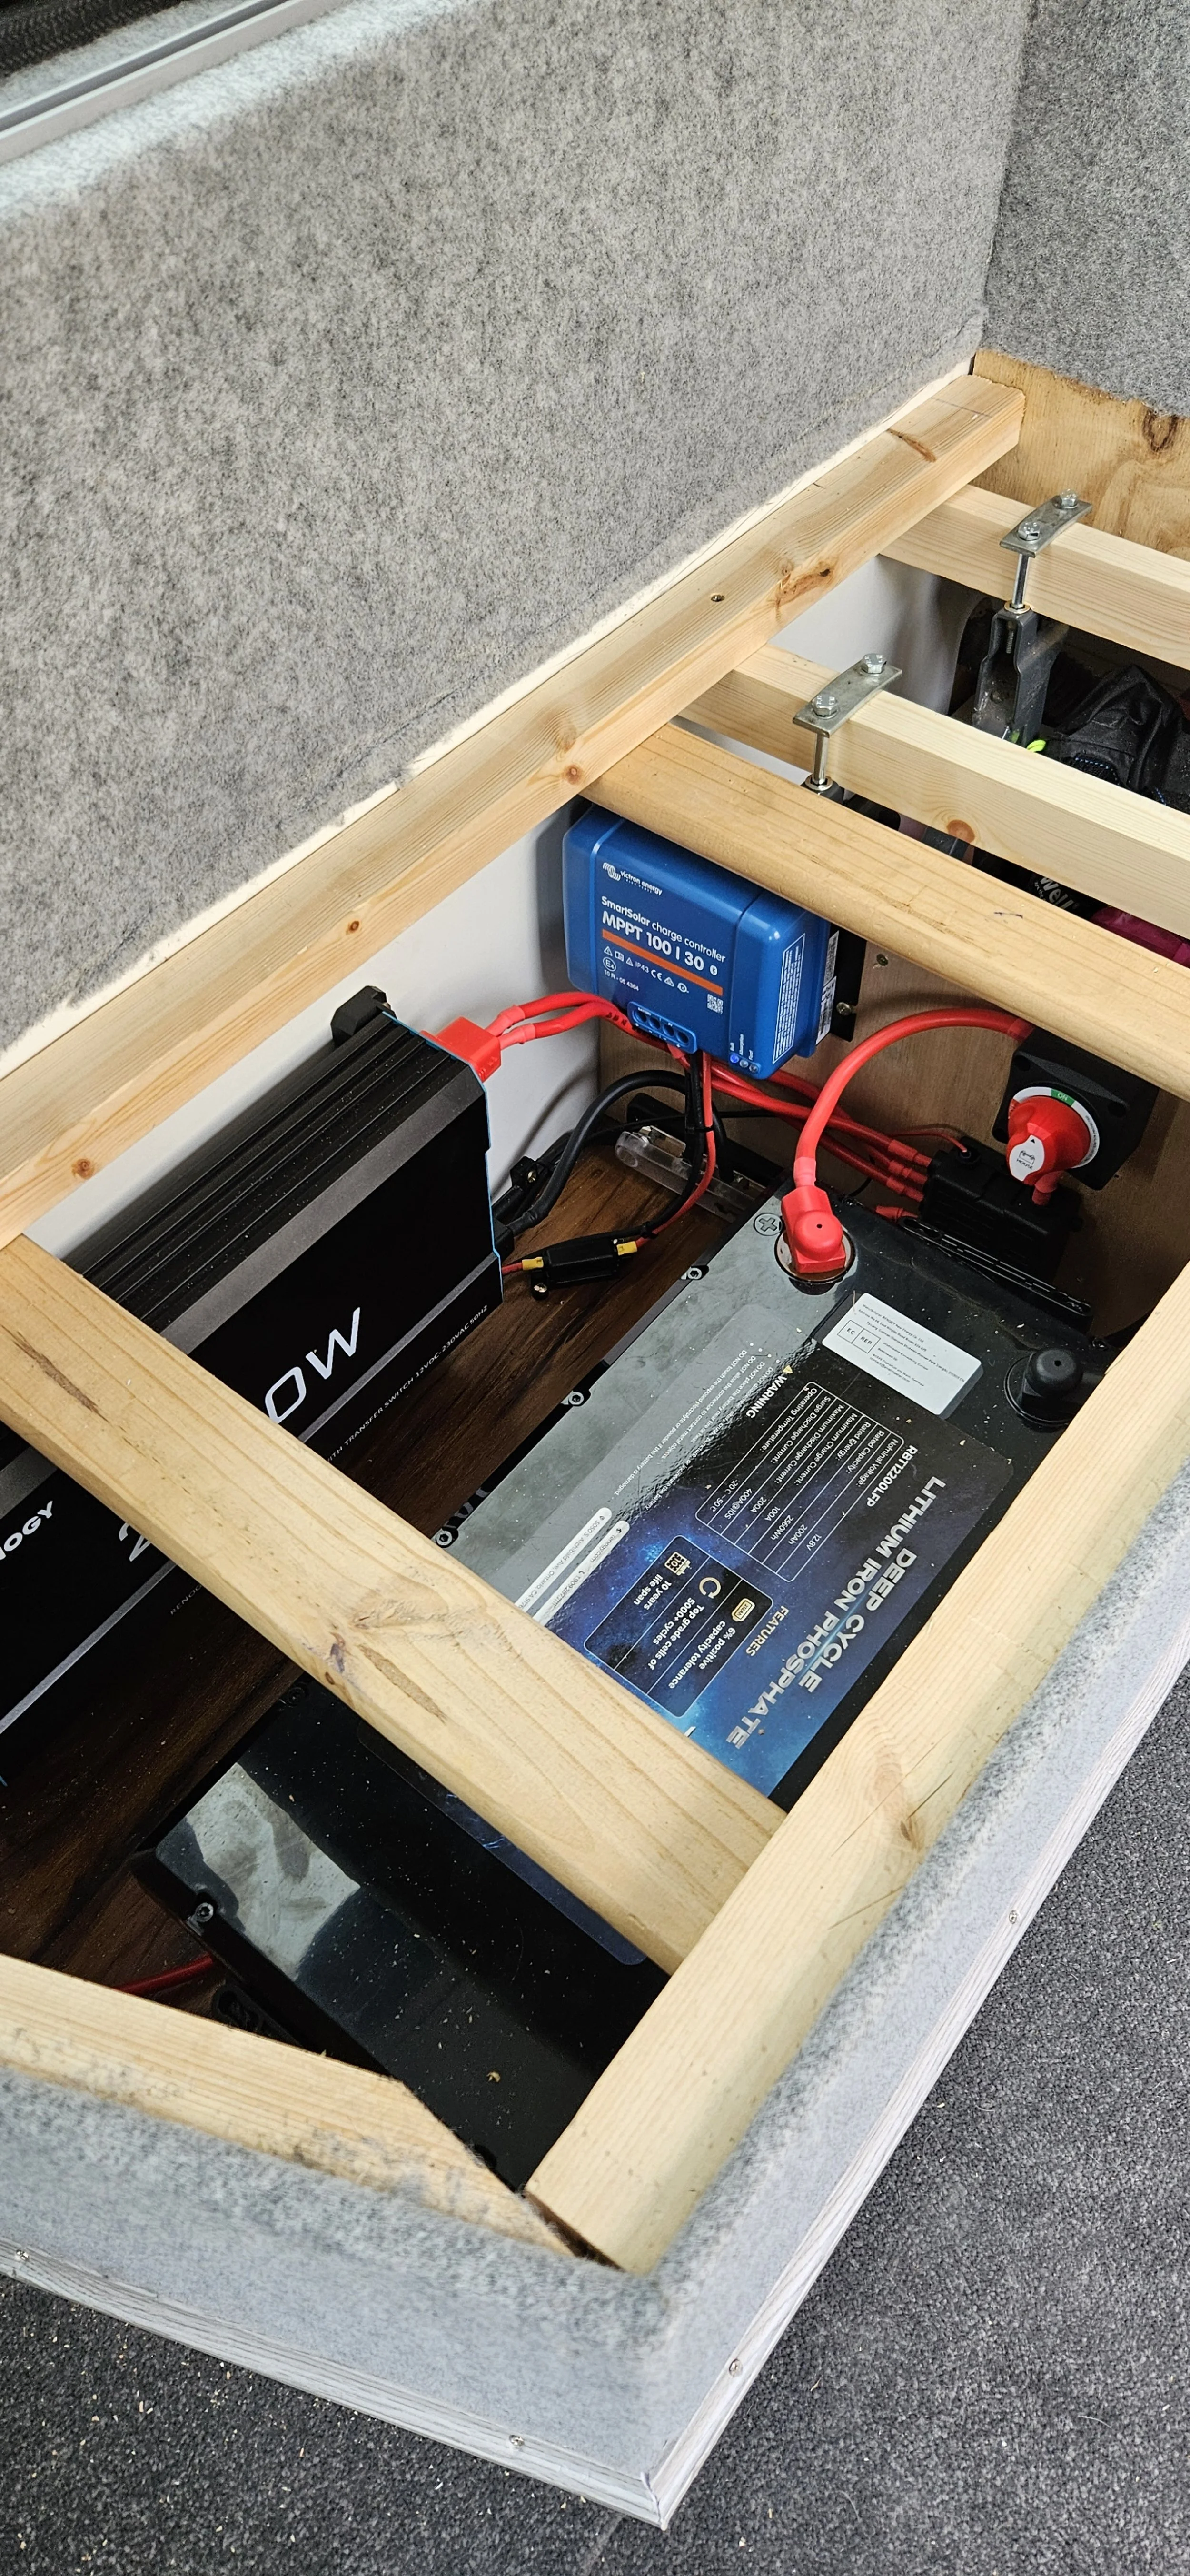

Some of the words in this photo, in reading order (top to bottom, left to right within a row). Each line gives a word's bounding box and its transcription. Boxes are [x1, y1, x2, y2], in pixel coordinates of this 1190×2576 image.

[620, 871, 640, 884] victron
[641, 881, 662, 895] energy
[601, 896, 651, 926] SmartSolar
[652, 922, 682, 942] charge
[684, 938, 726, 963] controller
[602, 911, 643, 941] MPPT
[646, 932, 672, 955] 100
[684, 951, 704, 971] 30
[635, 961, 649, 973] IP43
[1057, 1093, 1068, 1101] ON
[1016, 1158, 1034, 1170] HOUSE
[845, 1327, 856, 1335] EC
[859, 1336, 873, 1345] REP
[729, 1356, 741, 1367] NOT
[737, 1349, 747, 1359] DO
[746, 1355, 756, 1364] DO
[719, 1365, 733, 1379] touch
[739, 1362, 750, 1373] NOT
[747, 1368, 759, 1380] NOT
[755, 1361, 765, 1370] DO
[764, 1366, 774, 1375] DO
[327, 1446, 343, 1462] ITH
[344, 1407, 383, 1445] TRANSFER
[384, 1377, 413, 1408] SWITCH
[470, 1304, 487, 1324] 50HZ
[712, 1377, 723, 1386] the
[723, 1382, 733, 1391] the
[729, 1371, 742, 1384] allow
[737, 1376, 751, 1391] place
[755, 1373, 767, 1385] NOT
[696, 1383, 716, 1403] exposed
[704, 1389, 726, 1412] connector
[717, 1394, 735, 1412] battery
[731, 1388, 742, 1398] the
[744, 1373, 787, 1420] WARNING
[789, 1386, 818, 1417] Operating
[678, 1400, 701, 1425] electrolyte
[812, 1394, 831, 1414] Surge
[686, 1414, 704, 1432] contact
[703, 1420, 714, 1430] fire
[710, 1410, 721, 1421] near
[817, 1403, 844, 1434] Maximum
[660, 1426, 677, 1445] powder
[675, 1430, 689, 1444] metal
[758, 1413, 795, 1454] Temperature:
[789, 1411, 817, 1442] Discharge
[830, 1412, 858, 1442] Maximum
[853, 1421, 871, 1440] Rated
[793, 1430, 821, 1462] Discharge
[833, 1436, 857, 1462] Energy:
[866, 1429, 885, 1449] Rated
[650, 1446, 660, 1456] the
[769, 1438, 794, 1465] Current:
[812, 1439, 835, 1463] Charge
[843, 1444, 872, 1475] Capacity:
[874, 1437, 899, 1465] Nominal
[635, 1453, 653, 1472] battery
[774, 1458, 798, 1485] Current:
[793, 1460, 817, 1487] Current:
[854, 1461, 879, 1488] Voltage:
[867, 1445, 918, 1506] RBT12200LFP
[658, 1485, 669, 1496] the
[644, 1492, 662, 1512] battery
[723, 1486, 753, 1520] 400A@10S
[749, 1496, 766, 1514] 200A
[764, 1504, 780, 1522] 100A
[875, 1476, 946, 1558] LITHIUM
[586, 1519, 600, 1534] 5050
[769, 1514, 793, 1542] 2560Wh
[787, 1523, 808, 1546] 200Ah
[561, 1536, 585, 1562] Archibald
[534, 1568, 555, 1591] Ontario,
[648, 1573, 664, 1589] life
[659, 1579, 672, 1591] 10
[833, 1558, 882, 1611] IRON
[866, 1548, 917, 1611] DEEP
[527, 1589, 537, 1599] CA
[631, 1584, 652, 1607] span
[641, 1587, 664, 1611] years
[671, 1596, 695, 1623] 5000+
[686, 1601, 704, 1620] Top
[651, 1619, 676, 1647] cycles
[667, 1616, 693, 1643] grade
[696, 1618, 727, 1653] capacity
[721, 1625, 737, 1641] 6%
[744, 1604, 790, 1658] FEATURES
[654, 1639, 674, 1661] cells
[696, 1637, 727, 1671] positive
[798, 1614, 864, 1692] CYCLE
[646, 1657, 659, 1670] of
[667, 1651, 702, 1691] tolerance
[726, 1611, 840, 1749] PHOSPHATE
